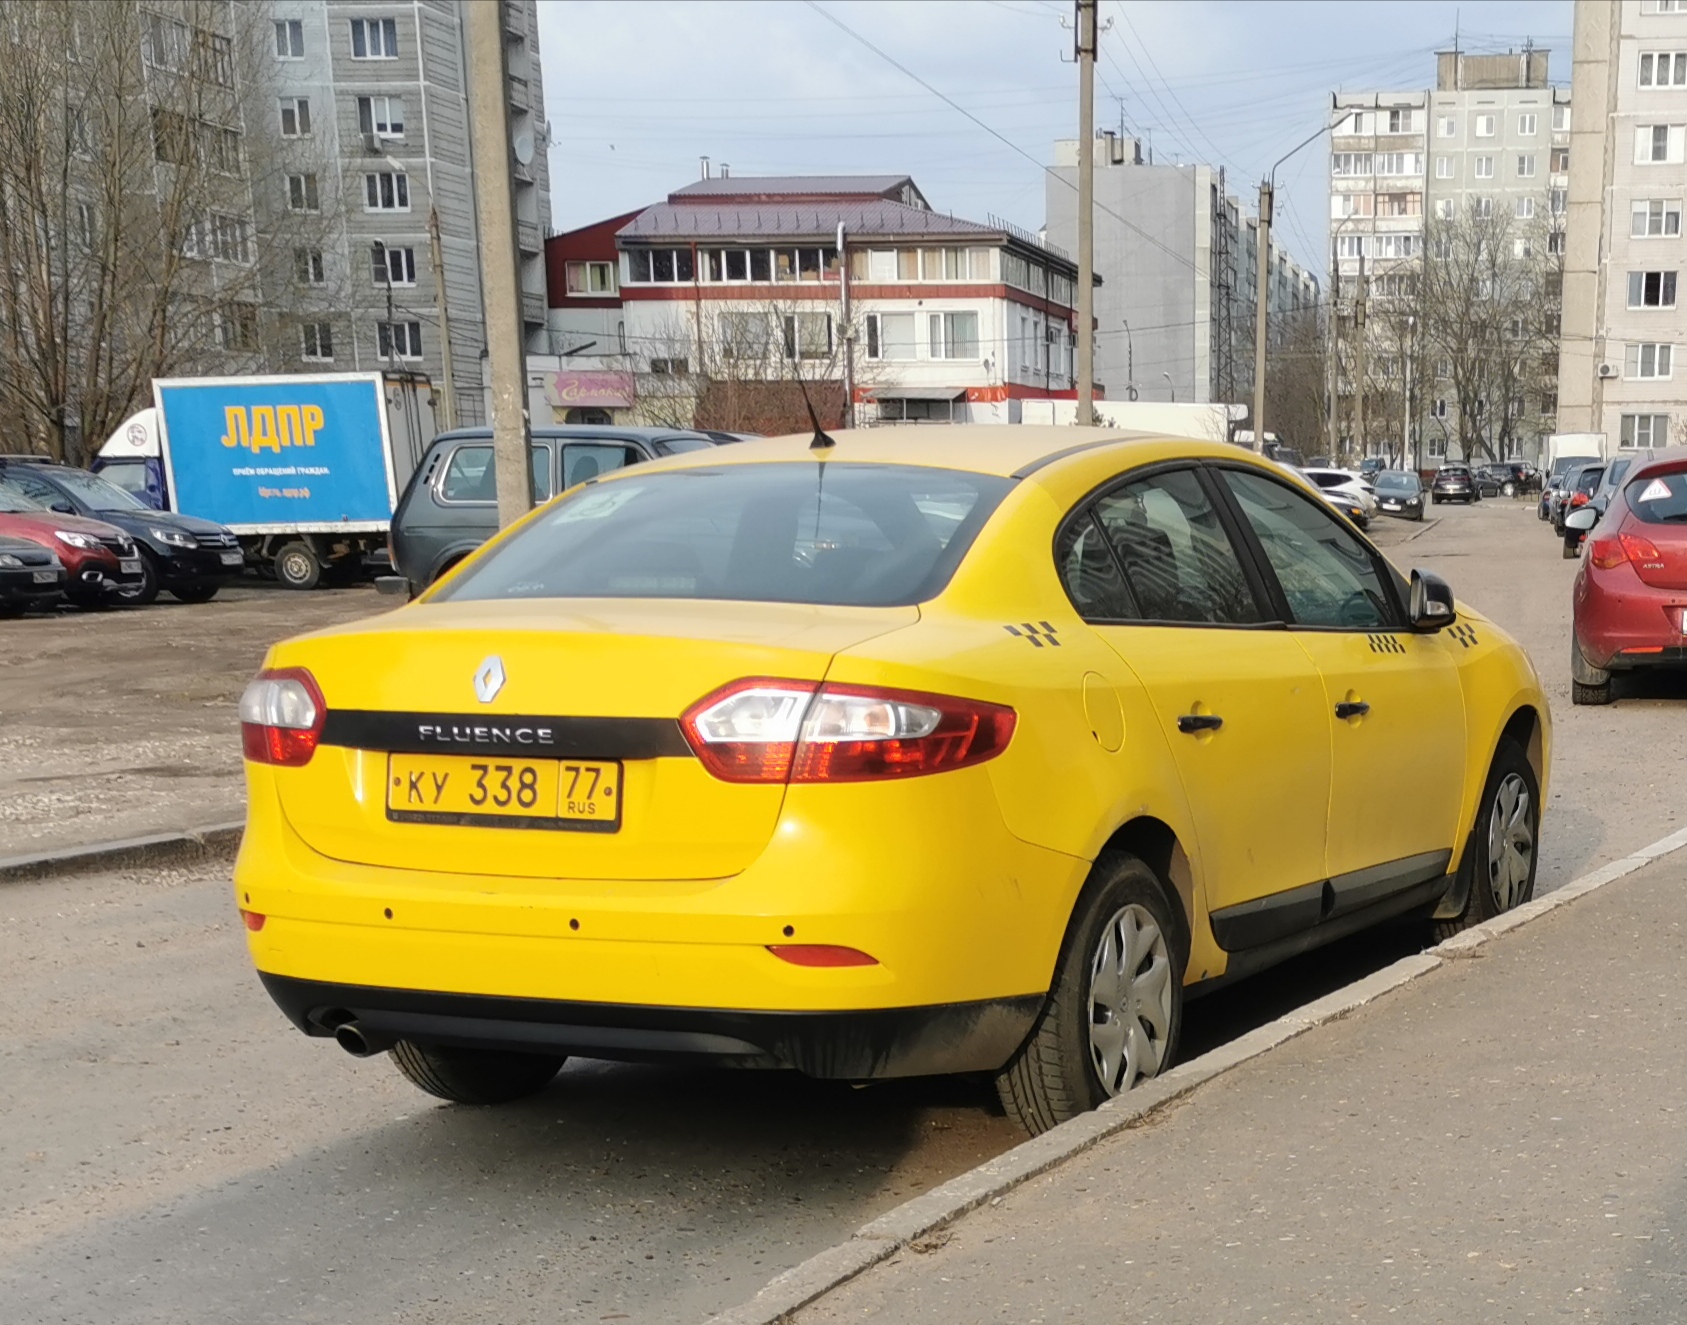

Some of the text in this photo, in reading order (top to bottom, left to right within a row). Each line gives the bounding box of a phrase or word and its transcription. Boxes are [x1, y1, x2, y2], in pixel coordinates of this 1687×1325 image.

[221, 404, 324, 454] ЛДПР
[418, 725, 554, 744] FLUENCE
[469, 763, 538, 809] 338
[565, 765, 601, 801] 77
[567, 801, 596, 815] RUS
